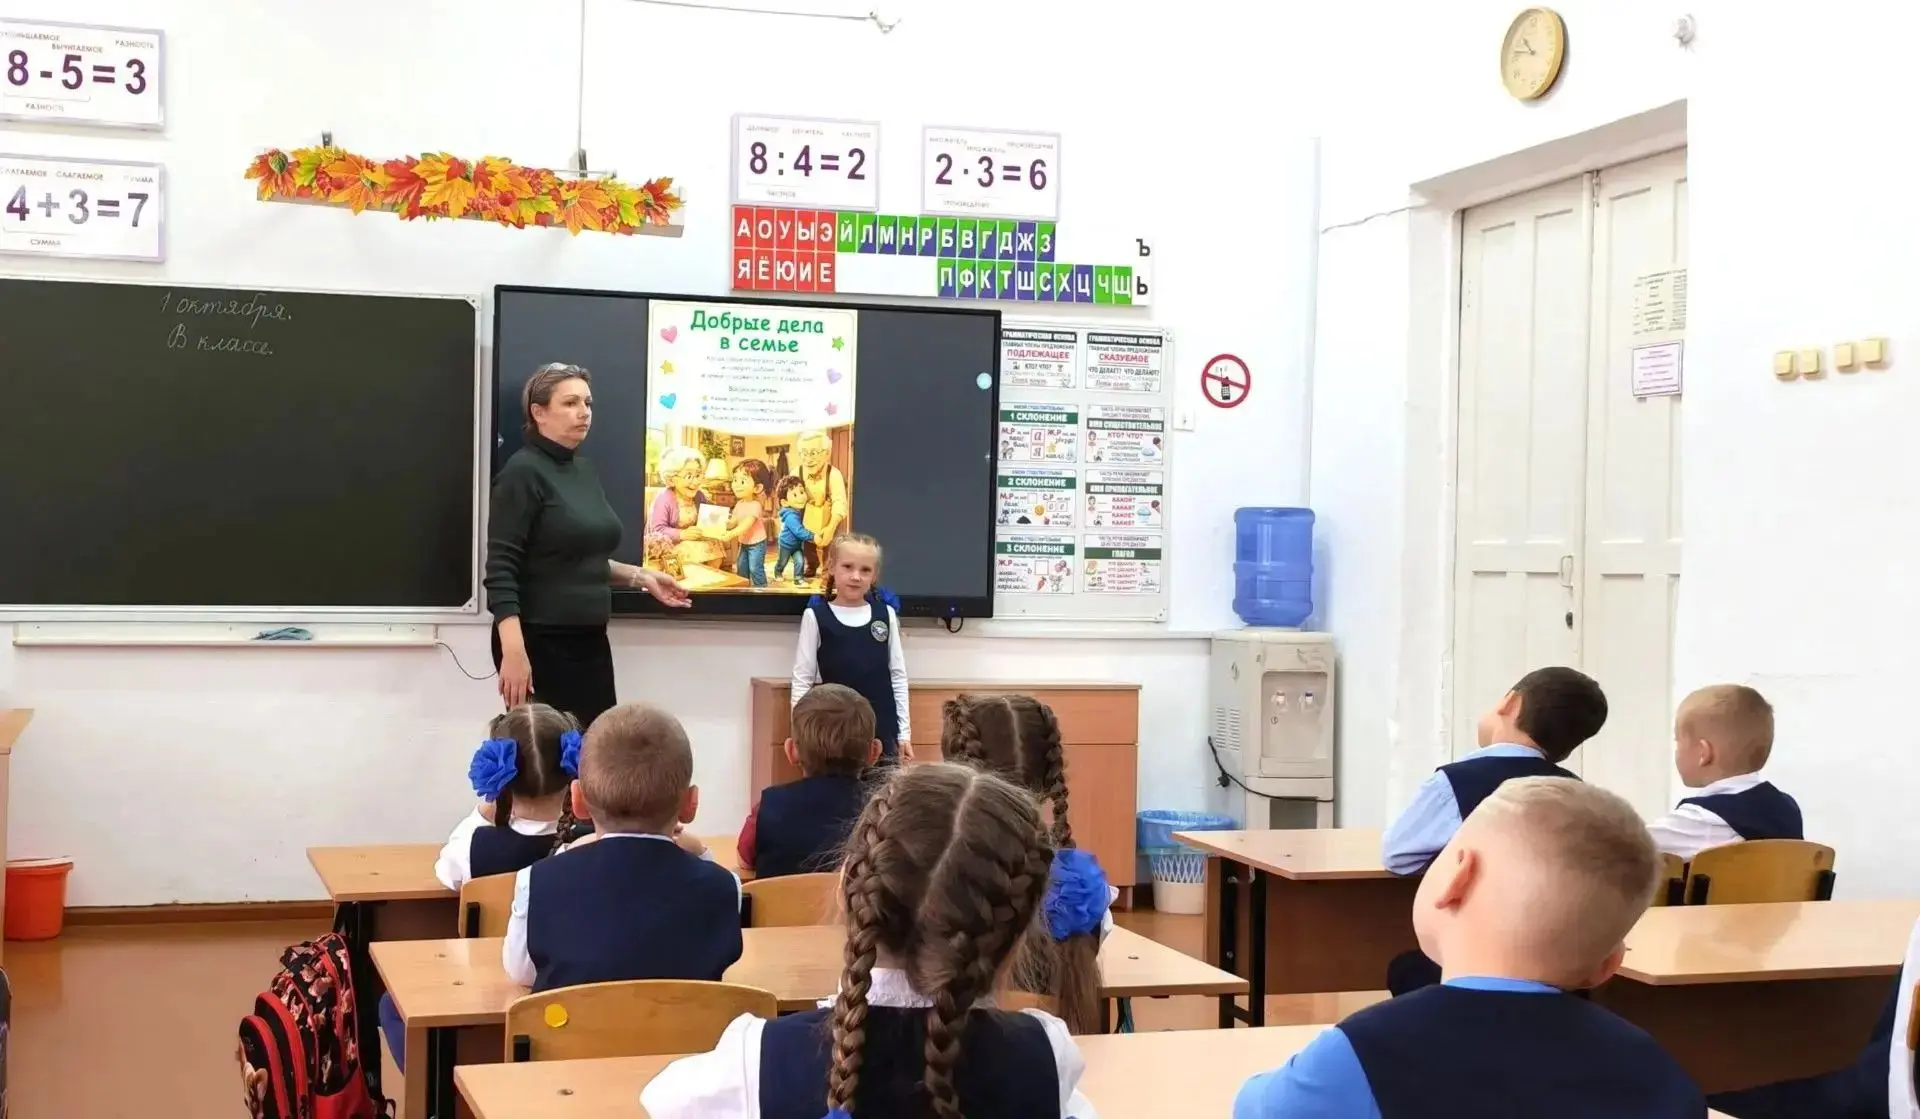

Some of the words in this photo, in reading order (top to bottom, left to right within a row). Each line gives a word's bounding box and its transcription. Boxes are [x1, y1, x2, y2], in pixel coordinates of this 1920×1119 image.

[161, 291, 172, 313] 1
[176, 292, 291, 329] октября.
[690, 310, 771, 335] Добрые
[777, 318, 824, 334] дела
[167, 323, 187, 349] В
[197, 335, 273, 355] классе.
[720, 336, 730, 350] в
[738, 337, 799, 353] семье
[1007, 349, 1070, 360] ПОДЛЕЖАЩЕЕ
[1099, 353, 1149, 363] СКАЗУЕМОЕ
[1016, 412, 1068, 422] СКЛОНЕНИЕ
[1008, 477, 1014, 486] 2
[1015, 477, 1067, 487] СКЛОНЕНИЕ
[1006, 543, 1012, 552] 3
[1013, 544, 1065, 554] СКЛОНЕНИЕ
[1112, 550, 1135, 558] ГЛАГОЛ
